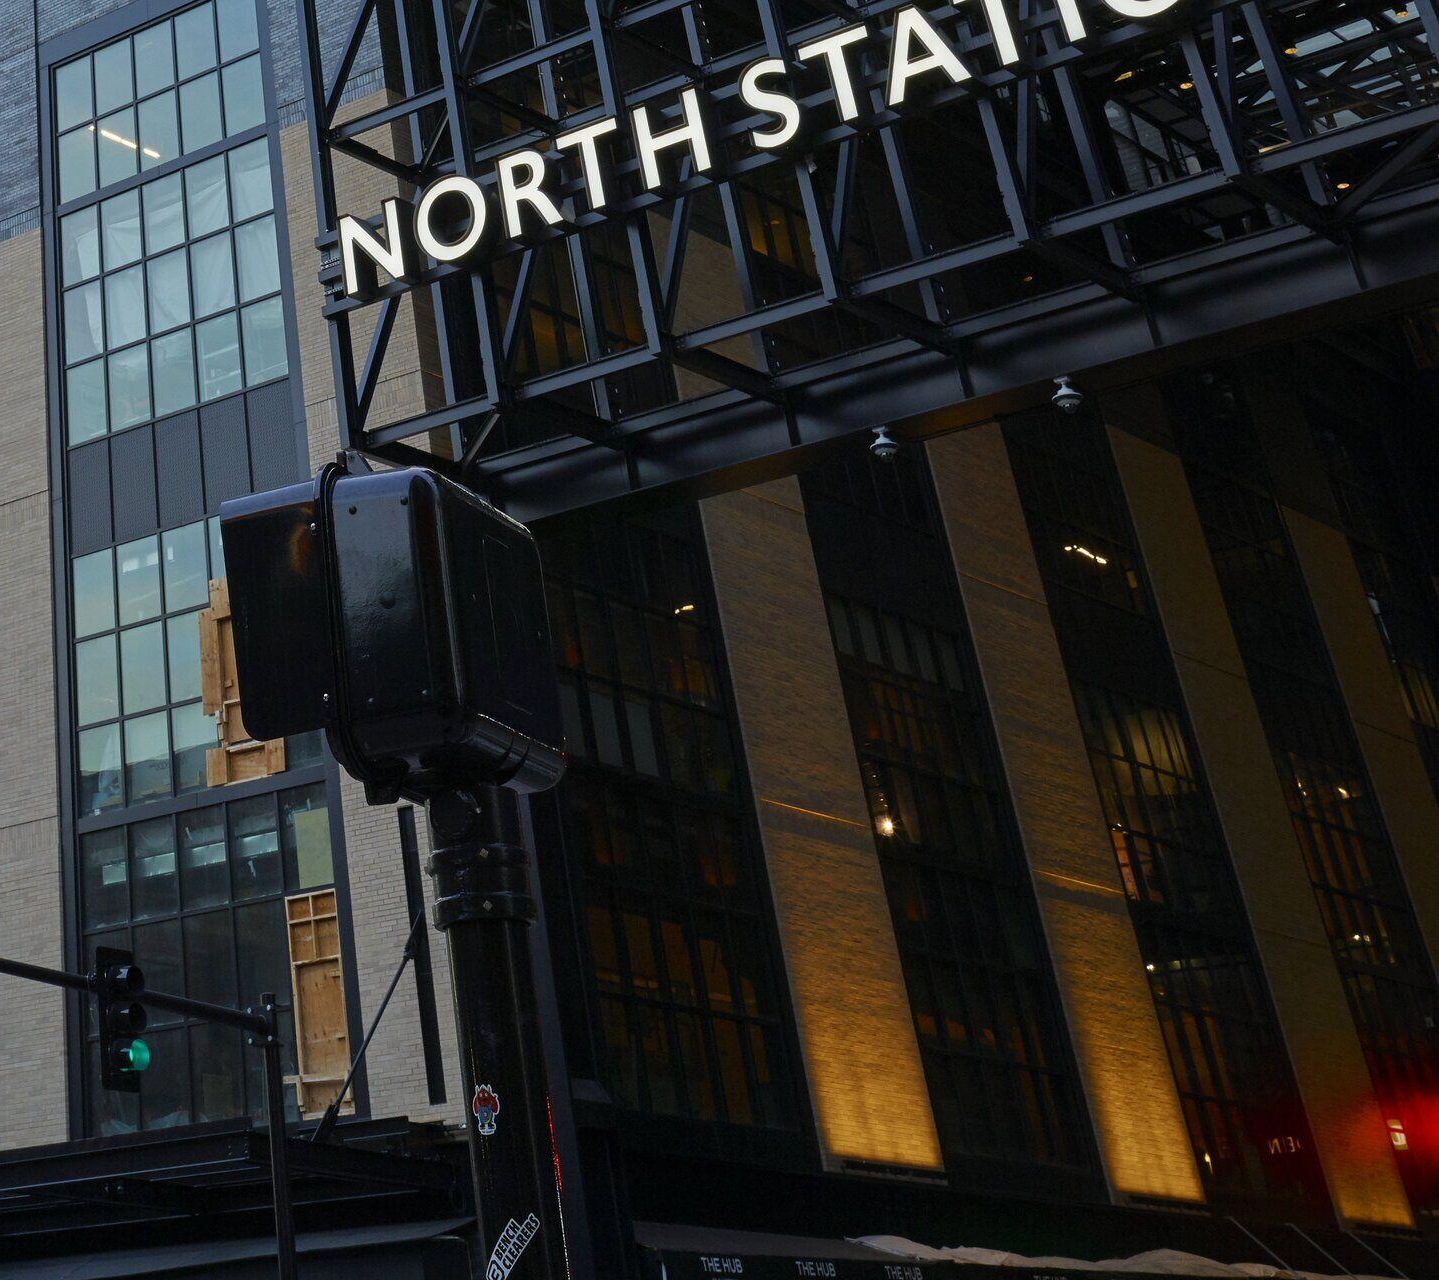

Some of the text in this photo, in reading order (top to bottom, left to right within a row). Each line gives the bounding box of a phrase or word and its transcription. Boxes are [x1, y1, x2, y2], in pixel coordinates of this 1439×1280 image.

[339, 87, 712, 297] NORTH
[494, 1220, 519, 1261] BENCH
[502, 1214, 538, 1270] CLEARERS
[701, 1257, 743, 1274] THE HUB
[795, 1261, 836, 1277] THE HUB
[884, 1265, 923, 1280] THE HUB
